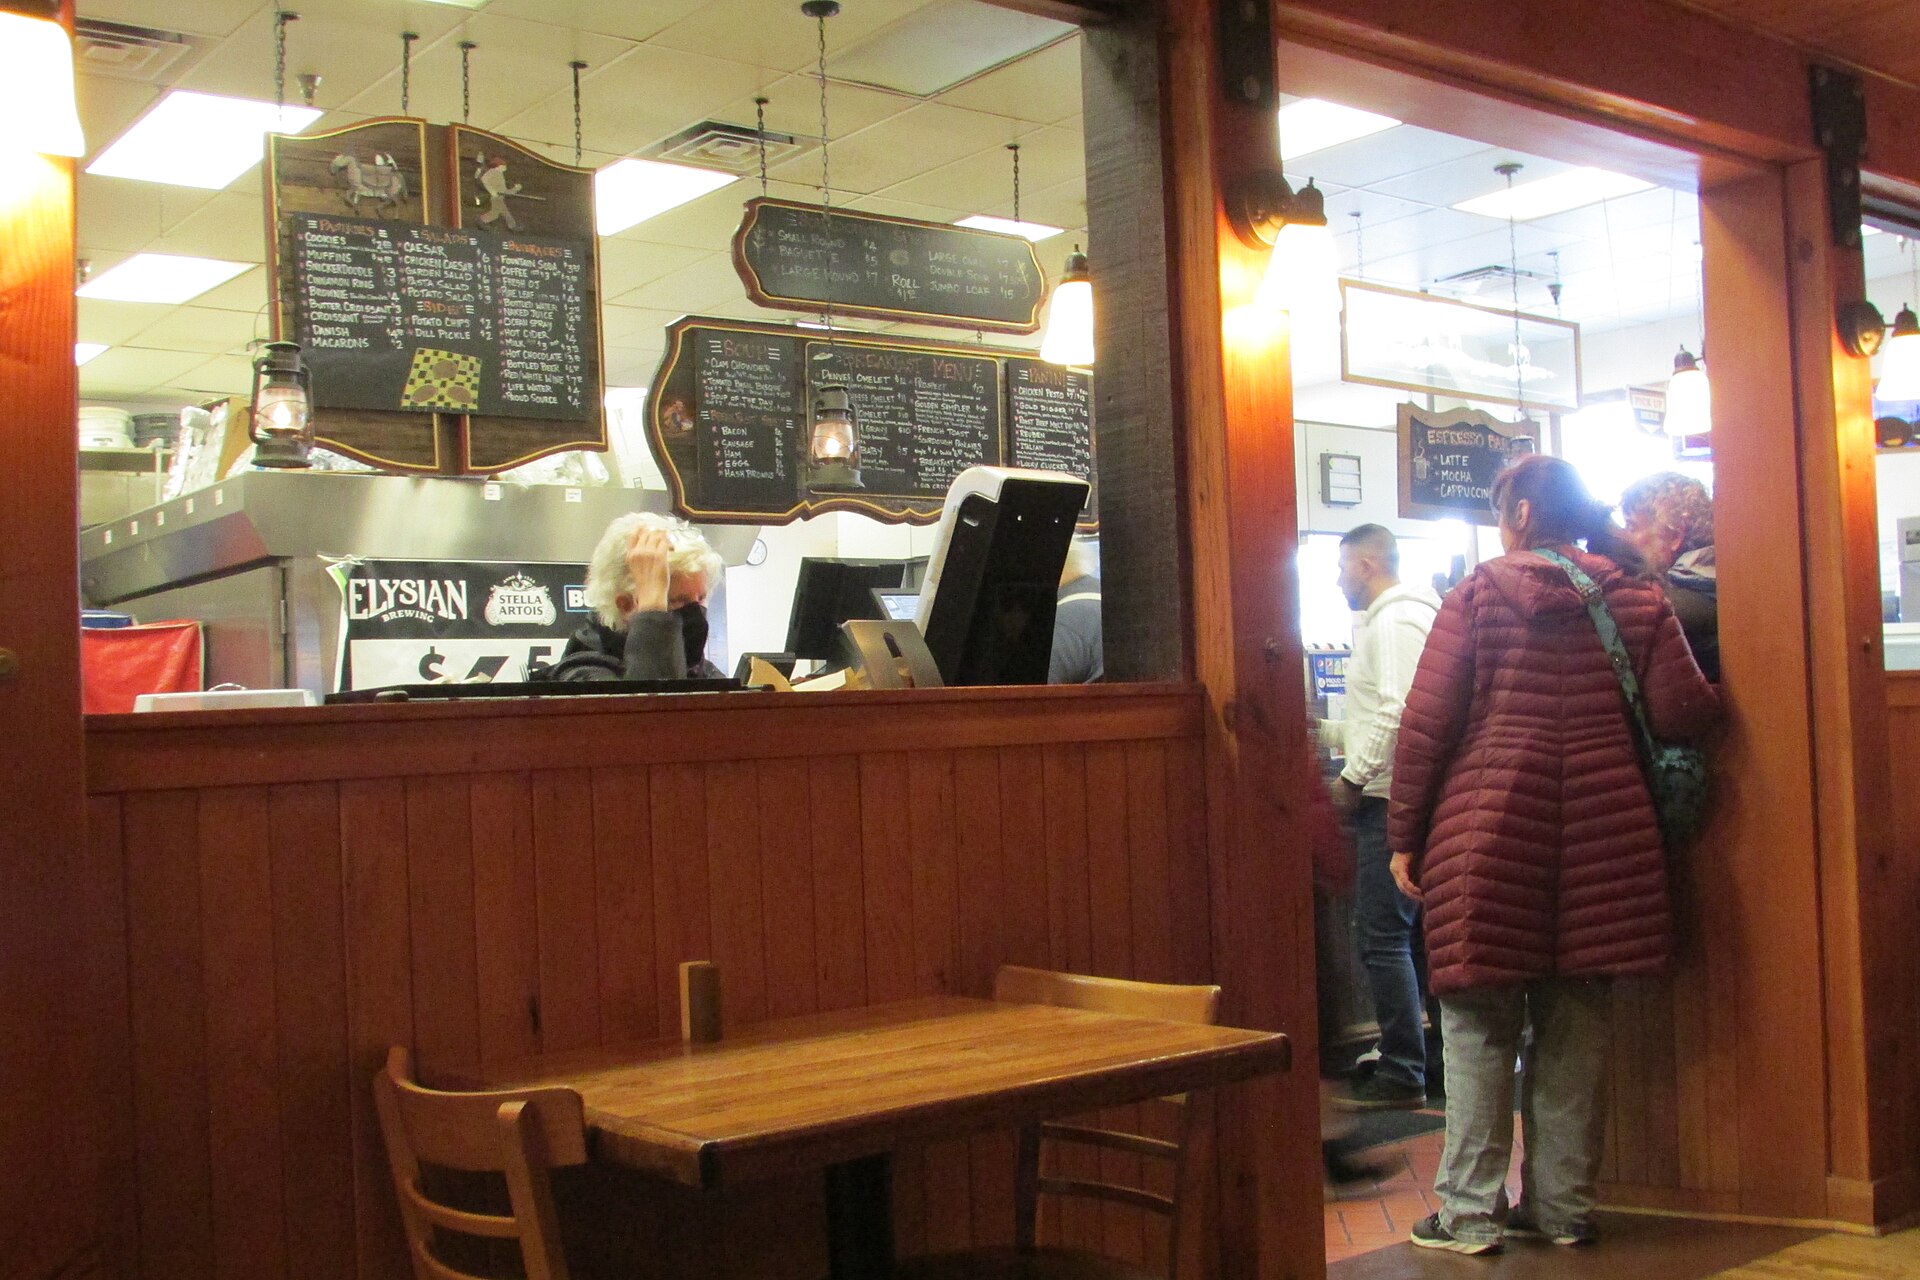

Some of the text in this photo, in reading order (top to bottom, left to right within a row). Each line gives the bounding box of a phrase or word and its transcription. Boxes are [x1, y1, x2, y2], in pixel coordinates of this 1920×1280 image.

[305, 232, 346, 245] COOKIES
[404, 241, 448, 259] CAESAR
[307, 250, 352, 263] MUFFINS
[404, 255, 441, 269] CHICKEN
[501, 255, 536, 268] FOUNTAIN
[405, 267, 441, 277] GARDEN
[443, 270, 473, 281] SALAD
[500, 265, 528, 278] COFFEE
[407, 276, 434, 287] PASTA
[437, 280, 470, 291] SALAD
[502, 277, 526, 288] FRESH
[891, 274, 920, 289] ROLL
[407, 287, 443, 299] POTATO
[445, 291, 475, 302] SALAD
[309, 298, 342, 311] BUTTER
[343, 301, 391, 314] CROISSANT
[503, 298, 534, 308] BOTTLED
[310, 311, 359, 323] CROISSANT
[503, 307, 554, 320] NAKED JUICE
[411, 315, 442, 327] POTATO
[444, 317, 471, 328] CHIPS
[312, 324, 350, 337] DANISH
[414, 328, 435, 338] DILL
[438, 329, 471, 340] PICKLE
[504, 328, 520, 337] HOT
[522, 329, 551, 340] CIDER
[312, 337, 369, 348] MACARONS
[505, 338, 526, 348] MILK
[505, 346, 563, 362] HOT CHOCOLATE
[506, 359, 560, 372] BOTTLED BEER
[544, 374, 564, 385] WINE
[856, 373, 891, 384] OMELET
[507, 383, 524, 391] LIFE
[526, 384, 553, 393] WATER
[1018, 386, 1065, 400] CHICKEN PESTO
[915, 400, 939, 409] GOLDEN
[1020, 402, 1039, 410] GOLD
[859, 409, 889, 419] OMELET
[721, 425, 748, 436] BACON
[917, 424, 945, 435] FRENCH
[946, 428, 970, 438] TOAST
[1020, 430, 1046, 439] REUBEN
[721, 439, 754, 449] SAUSAGE
[918, 435, 953, 446] SOURDOUGH
[1427, 429, 1485, 448] ESPRESSO
[1021, 443, 1044, 451] ITALIAN
[724, 449, 741, 458] HAM
[725, 460, 750, 468] EGGS
[919, 457, 954, 467] BREAKFAST
[1440, 454, 1469, 467] LATTE
[724, 469, 774, 479] HASH BROWNS
[1441, 470, 1472, 483] MOCHA
[349, 578, 468, 620] ELYSIAN
[499, 595, 542, 604] STELLA
[381, 609, 435, 623] BREWING
[499, 606, 543, 615] ARTOIS
